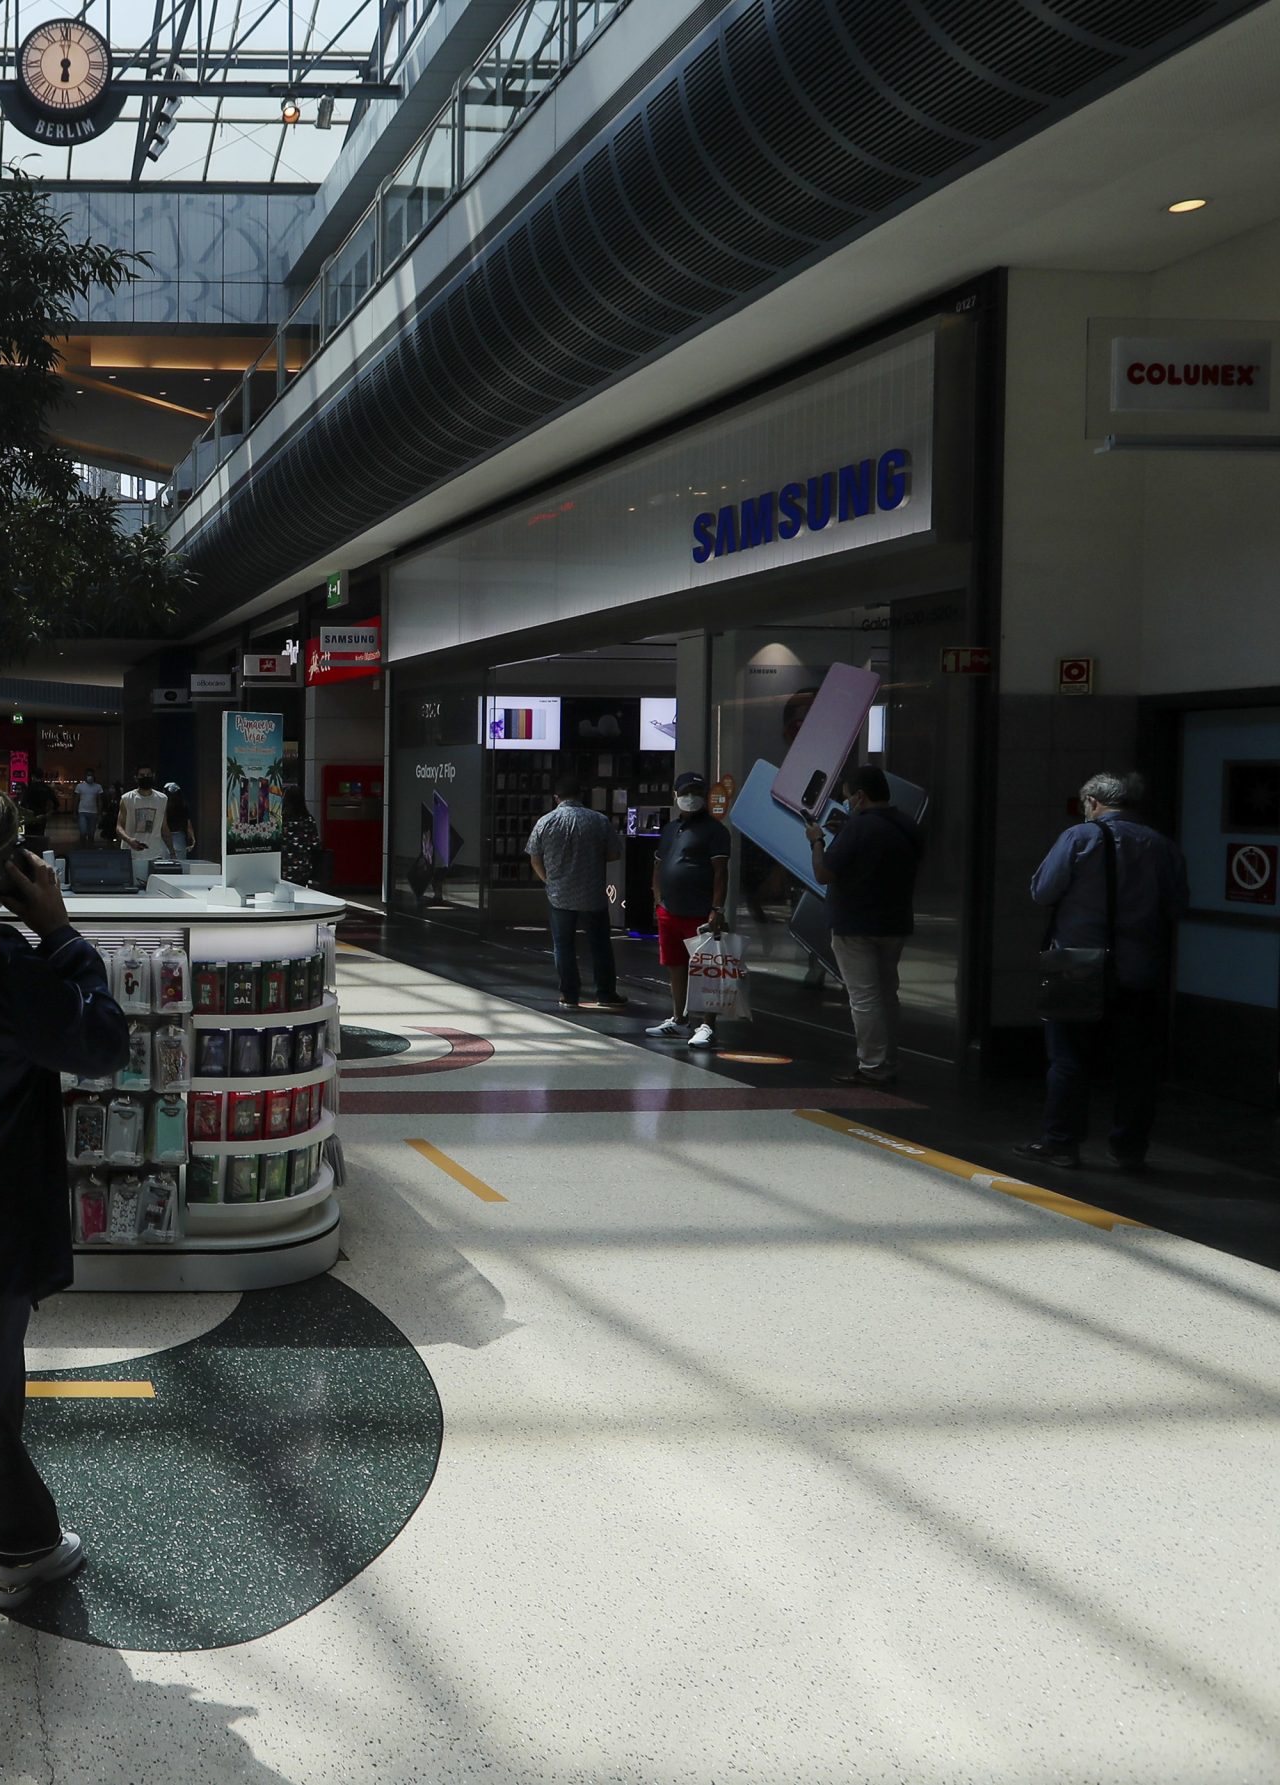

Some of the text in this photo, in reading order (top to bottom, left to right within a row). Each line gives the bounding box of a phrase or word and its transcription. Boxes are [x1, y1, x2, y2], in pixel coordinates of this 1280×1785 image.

[35, 119, 96, 138] BERLIM
[1126, 363, 1254, 386] COLUNEX
[692, 448, 910, 563] SAMSUNG
[324, 635, 375, 644] SAMSUNG
[416, 763, 438, 783] Galaxy
[444, 762, 456, 783] Flip
